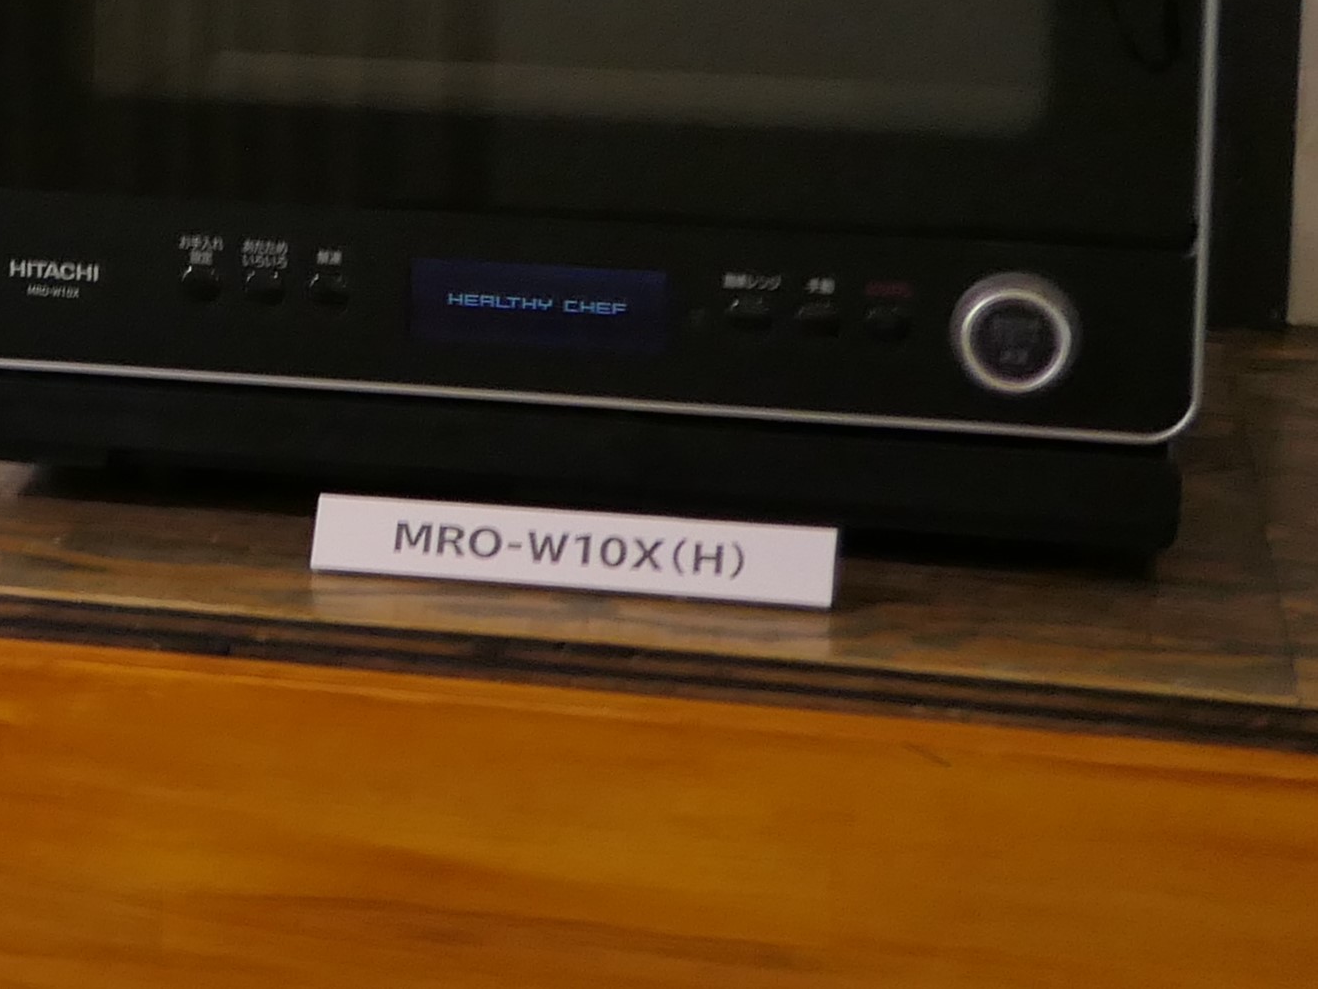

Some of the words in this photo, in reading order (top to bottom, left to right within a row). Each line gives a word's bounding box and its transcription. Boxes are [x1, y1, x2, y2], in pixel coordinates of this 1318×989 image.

[9, 258, 100, 283] HITACHI
[447, 292, 553, 311] HEALTHY
[563, 299, 628, 315] CHEF
[393, 521, 745, 578] MRO-W10X(H)
